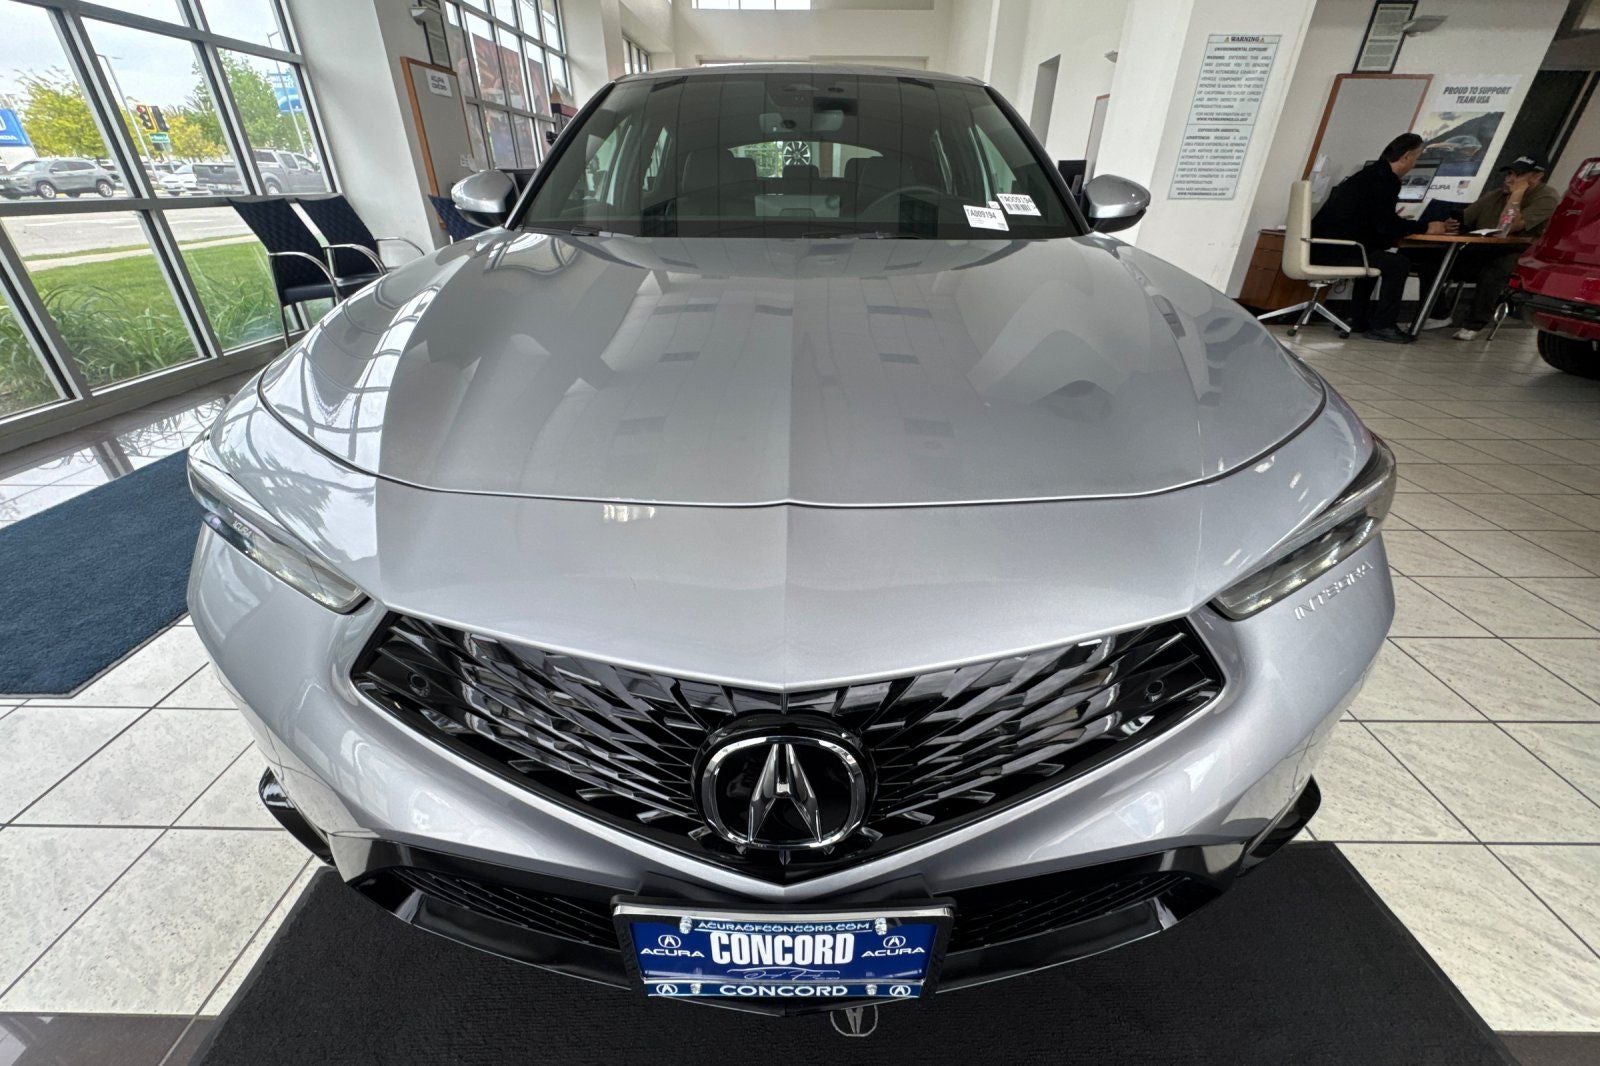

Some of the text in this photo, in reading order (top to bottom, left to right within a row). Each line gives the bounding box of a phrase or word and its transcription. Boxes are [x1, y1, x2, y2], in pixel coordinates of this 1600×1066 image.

[1443, 86, 1511, 94] PROUD TO SUPPORT
[966, 208, 996, 218] TA009194
[1294, 560, 1373, 620] INTEGRA
[698, 922, 870, 933] ACURAOFCONCORD.COM
[640, 948, 705, 958] ACURA
[710, 932, 854, 965] CONCORD
[860, 946, 926, 958] ACURA
[719, 984, 848, 998] CONCORD
